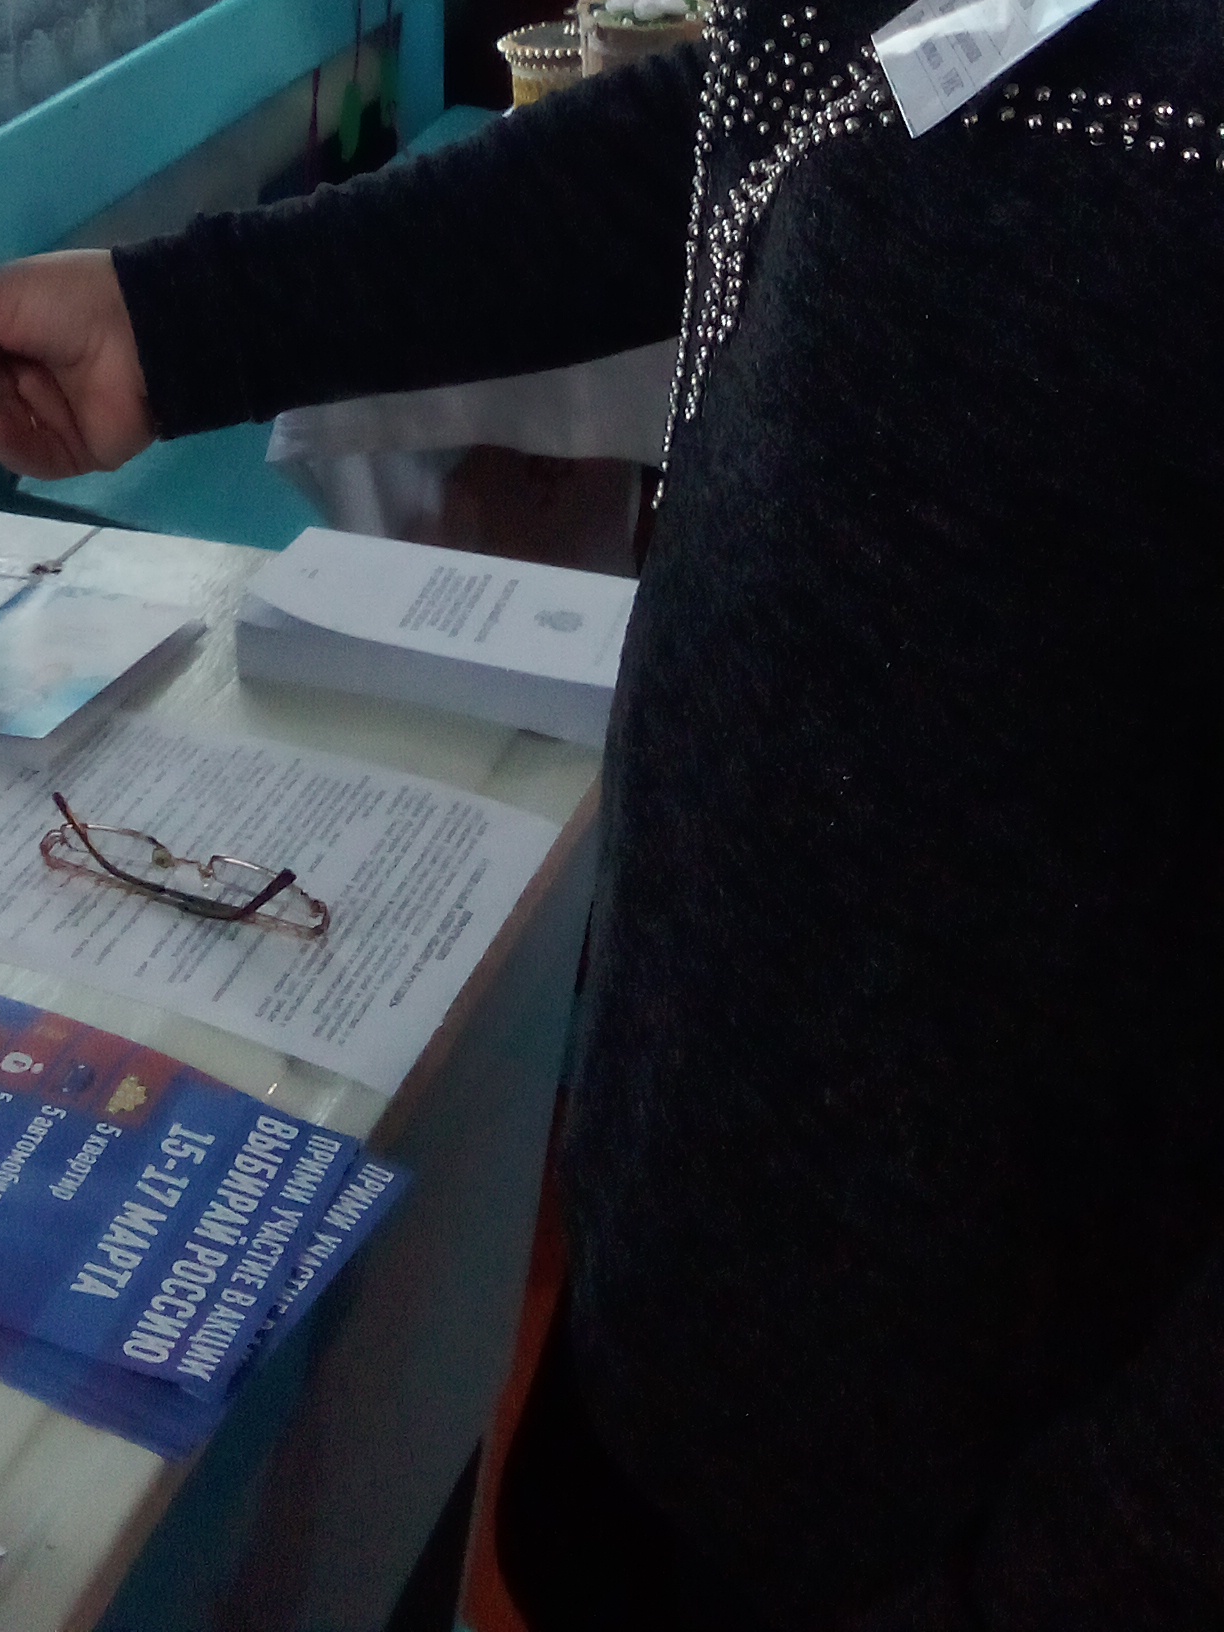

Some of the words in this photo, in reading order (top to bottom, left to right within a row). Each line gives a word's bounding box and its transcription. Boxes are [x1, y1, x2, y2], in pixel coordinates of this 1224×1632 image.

[37, 1103, 68, 1119] 5
[93, 1121, 123, 1138] 5
[43, 1132, 112, 1202] квартир
[133, 1121, 217, 1208] 15-17
[192, 1115, 301, 1247] ВЫБИРАЙ
[278, 1134, 343, 1204] ПРИМИ
[321, 1161, 395, 1233] ПРИМИ
[68, 1200, 170, 1300] МАРТА
[228, 1206, 304, 1289] УЧАСТИЕ
[119, 1241, 229, 1365] РОССИЮ
[218, 1287, 257, 1307] В
[175, 1303, 247, 1382] АКЦИИ
